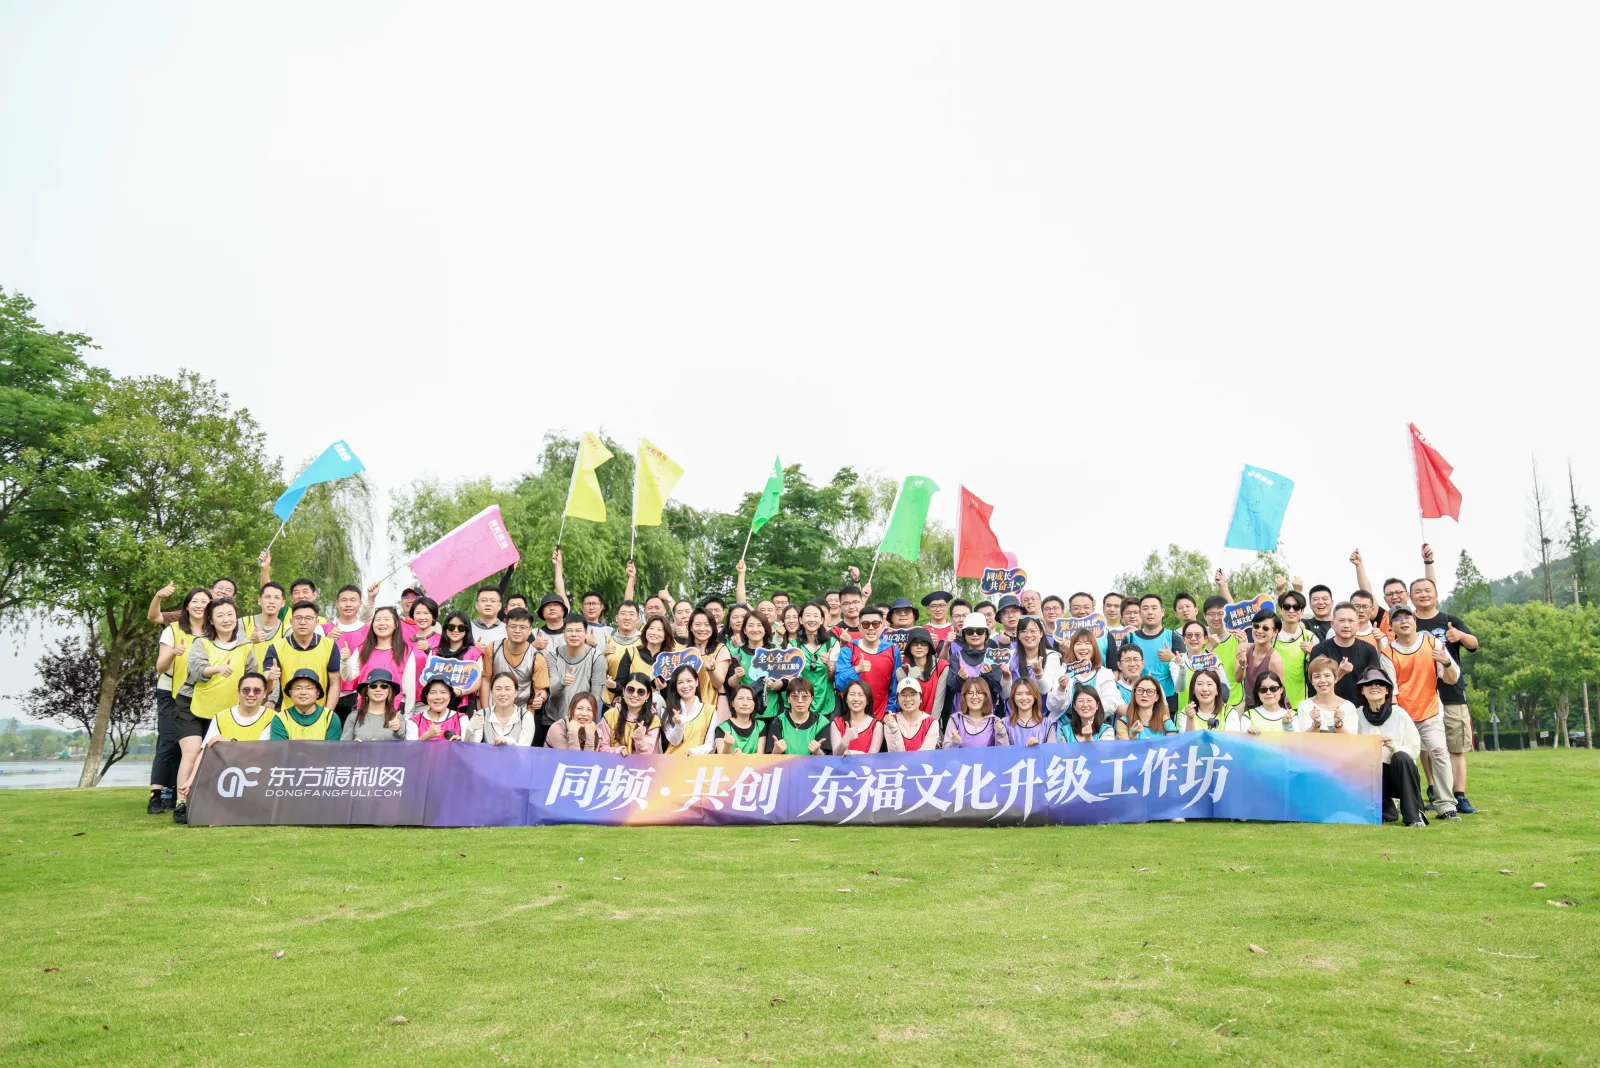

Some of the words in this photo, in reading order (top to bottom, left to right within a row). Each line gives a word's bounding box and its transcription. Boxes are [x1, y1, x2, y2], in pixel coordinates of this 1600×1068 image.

[987, 571, 1012, 581] 同成长
[990, 580, 1016, 591] 共奋斗
[758, 653, 791, 663] 全心全意
[433, 662, 472, 674] 同心同向
[451, 673, 470, 683] 同行
[267, 766, 405, 787] 东方福利网
[545, 762, 784, 816] 同频·共创
[797, 744, 1233, 825] 东福文化升级工作坊
[265, 789, 402, 798] DONGFANGFULI.COM
